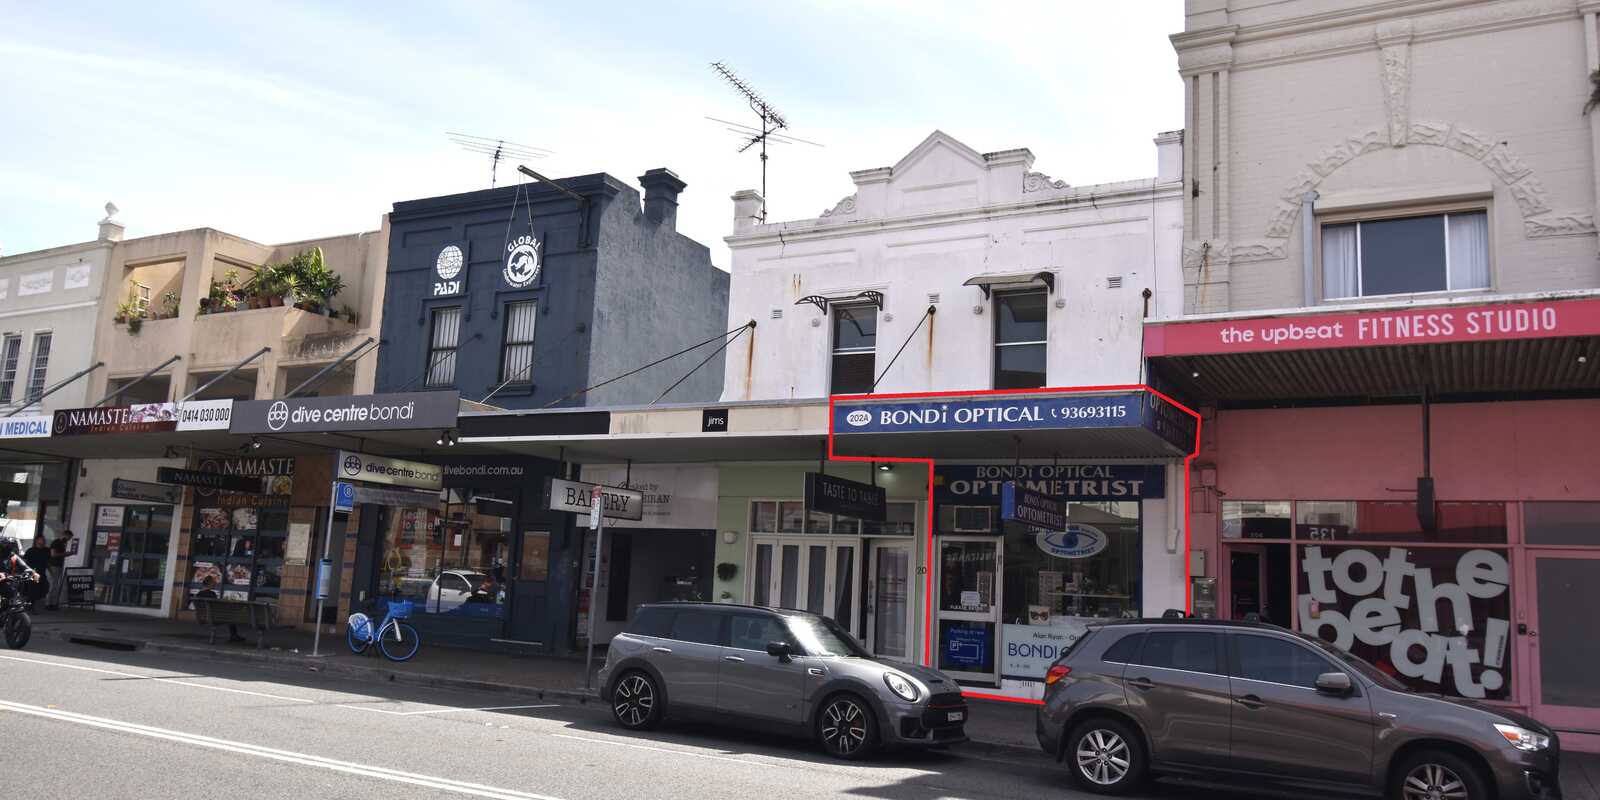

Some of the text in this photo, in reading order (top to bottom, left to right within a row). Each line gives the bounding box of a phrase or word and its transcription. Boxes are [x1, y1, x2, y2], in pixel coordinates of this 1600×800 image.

[507, 235, 541, 253] GLOBAL
[433, 280, 461, 296] PADI
[1358, 307, 1557, 340] FITNESS STUDIO
[1220, 321, 1344, 345] the upbeat
[68, 408, 129, 427] NAMASTE
[182, 407, 230, 423] 0414 030 000
[291, 402, 414, 423] dive centre bondi
[849, 414, 869, 423] 202A
[880, 405, 1126, 425] BONDi OPTICAL 93693115
[5, 421, 48, 436] MEDICAL
[707, 416, 725, 428] jims
[223, 458, 295, 476] NAMASTE
[365, 462, 386, 474] dive
[386, 466, 414, 478] centre
[1039, 466, 1114, 478] OPTICAL
[823, 481, 846, 500] TASTE
[950, 480, 1144, 496] OPTMETRIST
[565, 487, 632, 512] BAERY
[1017, 504, 1063, 528] OPTOMETRIST
[1008, 642, 1058, 659] BONDI
